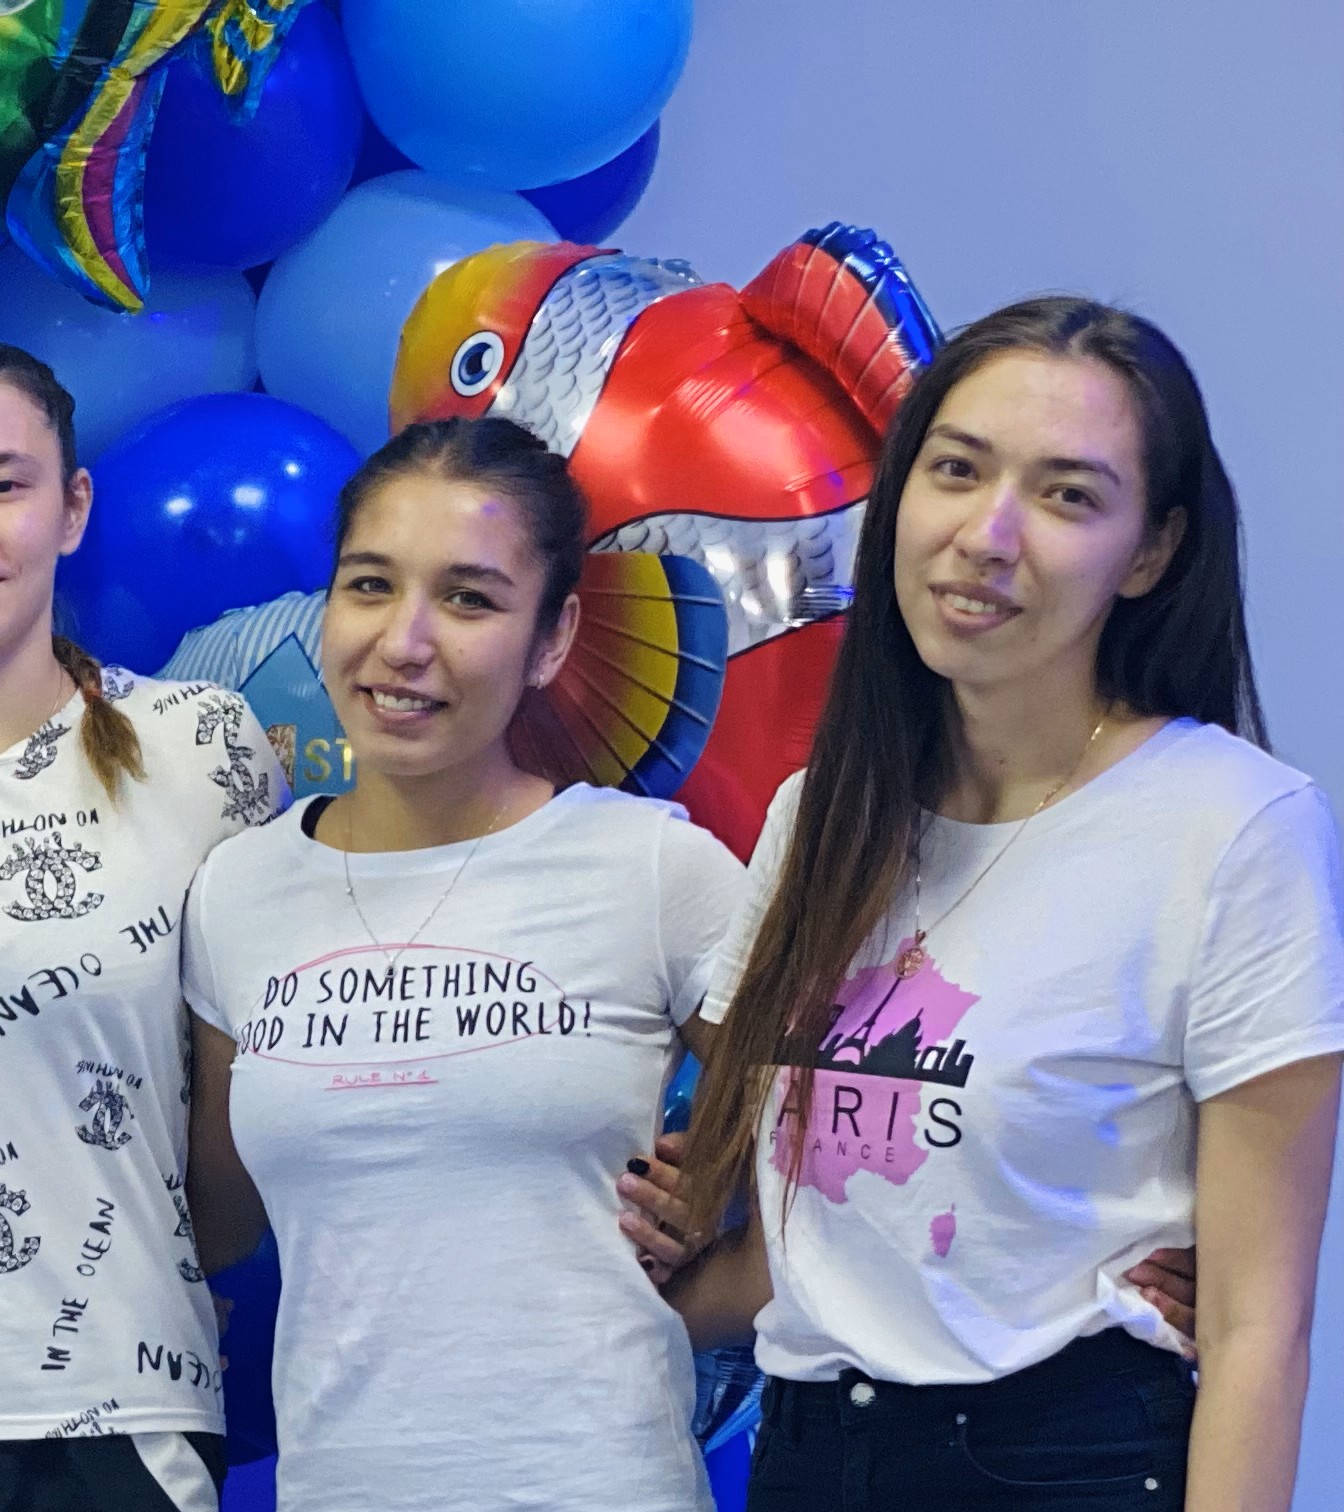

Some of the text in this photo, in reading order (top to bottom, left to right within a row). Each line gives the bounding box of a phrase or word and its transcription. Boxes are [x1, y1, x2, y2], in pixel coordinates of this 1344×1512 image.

[119, 905, 177, 953] THE
[263, 961, 537, 1010] DO SOMETHING
[236, 1001, 591, 1055] OOD IN THE WORLD!
[76, 1060, 123, 1079] NTHING
[332, 1072, 382, 1086] RULE
[777, 1084, 963, 1148] ARIS
[770, 1131, 896, 1164] FANCE
[41, 1196, 114, 1370] IN THE OCEAN
